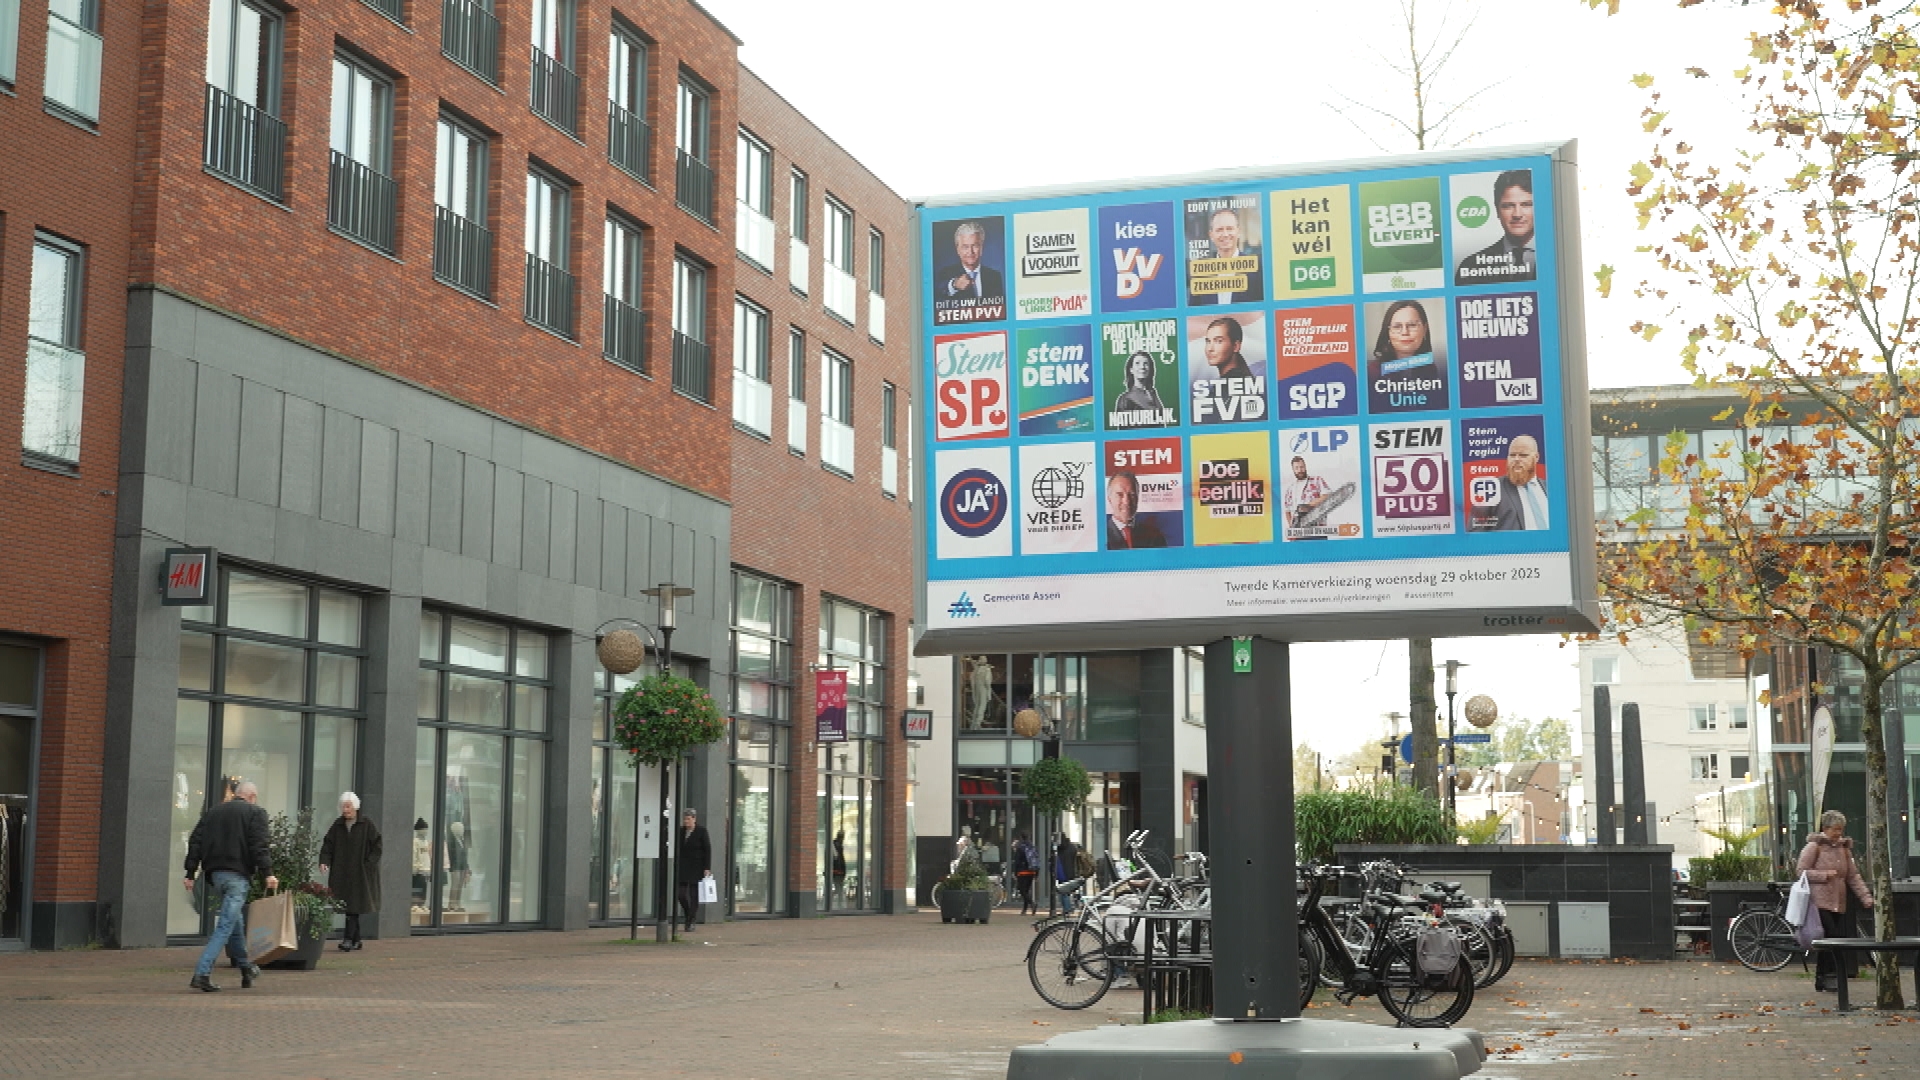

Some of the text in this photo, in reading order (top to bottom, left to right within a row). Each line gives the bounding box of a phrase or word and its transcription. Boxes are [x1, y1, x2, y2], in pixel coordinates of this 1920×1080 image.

[1291, 197, 1330, 215] Het
[1368, 201, 1433, 227] BBB
[1459, 206, 1487, 218] CDA
[1115, 220, 1158, 240] kies
[1292, 219, 1330, 235] kan
[1032, 233, 1075, 249] SAMEN
[1292, 236, 1331, 254] wél
[1028, 255, 1080, 270] VOORUIT
[1193, 259, 1255, 273] ZORGEN VOOR
[1476, 252, 1513, 265] Henri
[1294, 265, 1331, 282] D66
[1460, 263, 1530, 277] Bontenbal
[936, 301, 950, 309] DIT
[951, 299, 960, 308] IS
[960, 297, 976, 307] UW
[1053, 295, 1083, 311] PvdA
[1460, 296, 1533, 319] DOE IETS
[938, 306, 1002, 322] STEM PVV
[1144, 320, 1176, 337] VOOR
[1462, 316, 1529, 339] NIEUWS
[1112, 338, 1127, 355] DE
[1284, 336, 1313, 345] VOOR
[937, 343, 1005, 378] Stem
[1026, 342, 1084, 364] stem
[1022, 362, 1090, 388] DENK
[1464, 360, 1512, 381] STEM
[1193, 376, 1264, 398] STEM
[1374, 377, 1442, 393] Christen
[1501, 383, 1532, 397] Volt
[1289, 381, 1346, 411] SGP
[1389, 391, 1428, 407] Unie
[1193, 395, 1265, 423] FVD
[1374, 426, 1443, 449] STEM
[1468, 427, 1497, 436] Stem
[1311, 430, 1349, 452] LP
[1469, 436, 1508, 447] voor de
[1114, 447, 1172, 467] STEM
[1199, 461, 1240, 479] Doe
[1383, 457, 1439, 494] 50
[1470, 465, 1499, 474] Stem
[1200, 481, 1264, 504] eerlijk.
[1385, 495, 1438, 513] PLUS
[1027, 509, 1082, 525] VREDE
[169, 562, 203, 588] H&M
[1225, 567, 1541, 592] Tweede Kamerverkiezing woensdag 29 oktober 2025
[983, 591, 1061, 603] Gemeente Assen
[1226, 598, 1245, 607] Meer
